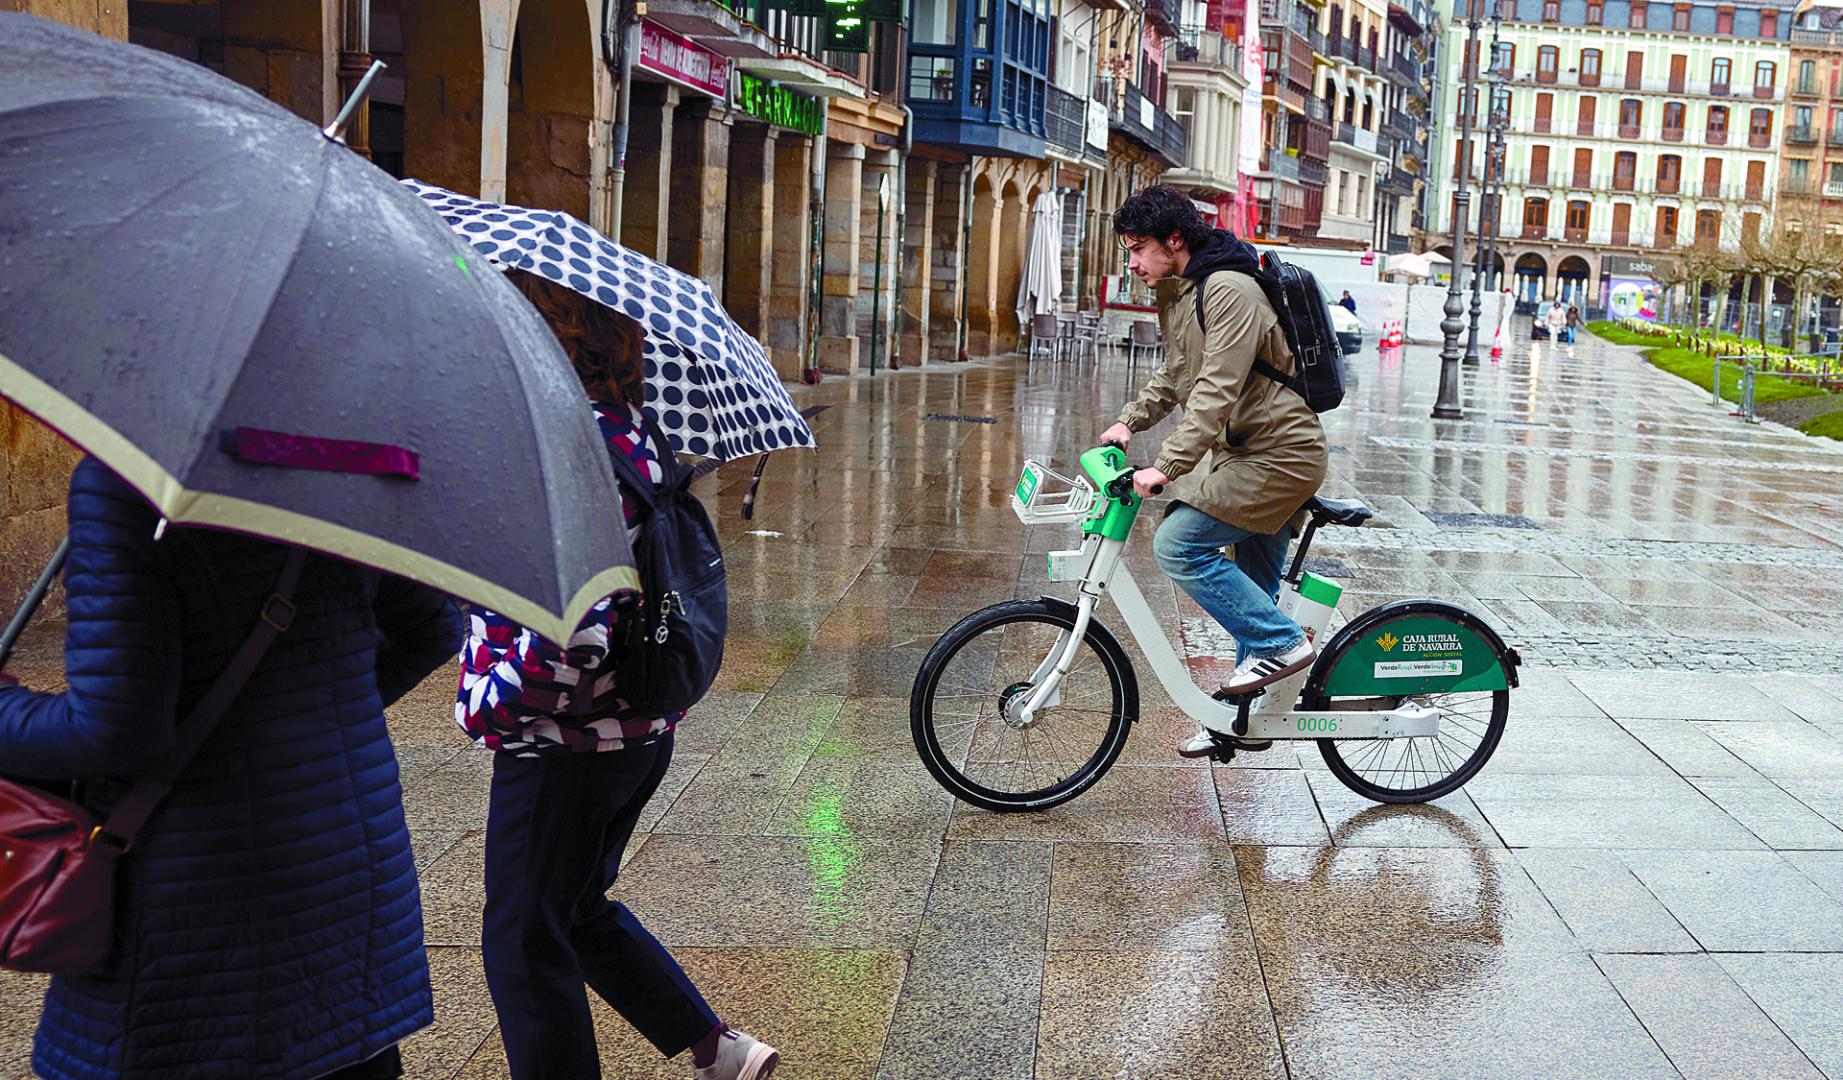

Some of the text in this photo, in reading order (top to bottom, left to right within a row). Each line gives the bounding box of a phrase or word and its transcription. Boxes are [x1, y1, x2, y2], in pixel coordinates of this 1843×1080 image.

[755, 79, 824, 135] FARMACIA
[1629, 262, 1654, 272] saba
[1402, 634, 1459, 644] CAJA RURAL
[1402, 642, 1463, 652] DE NAVARRA
[1296, 717, 1338, 731] 0006
